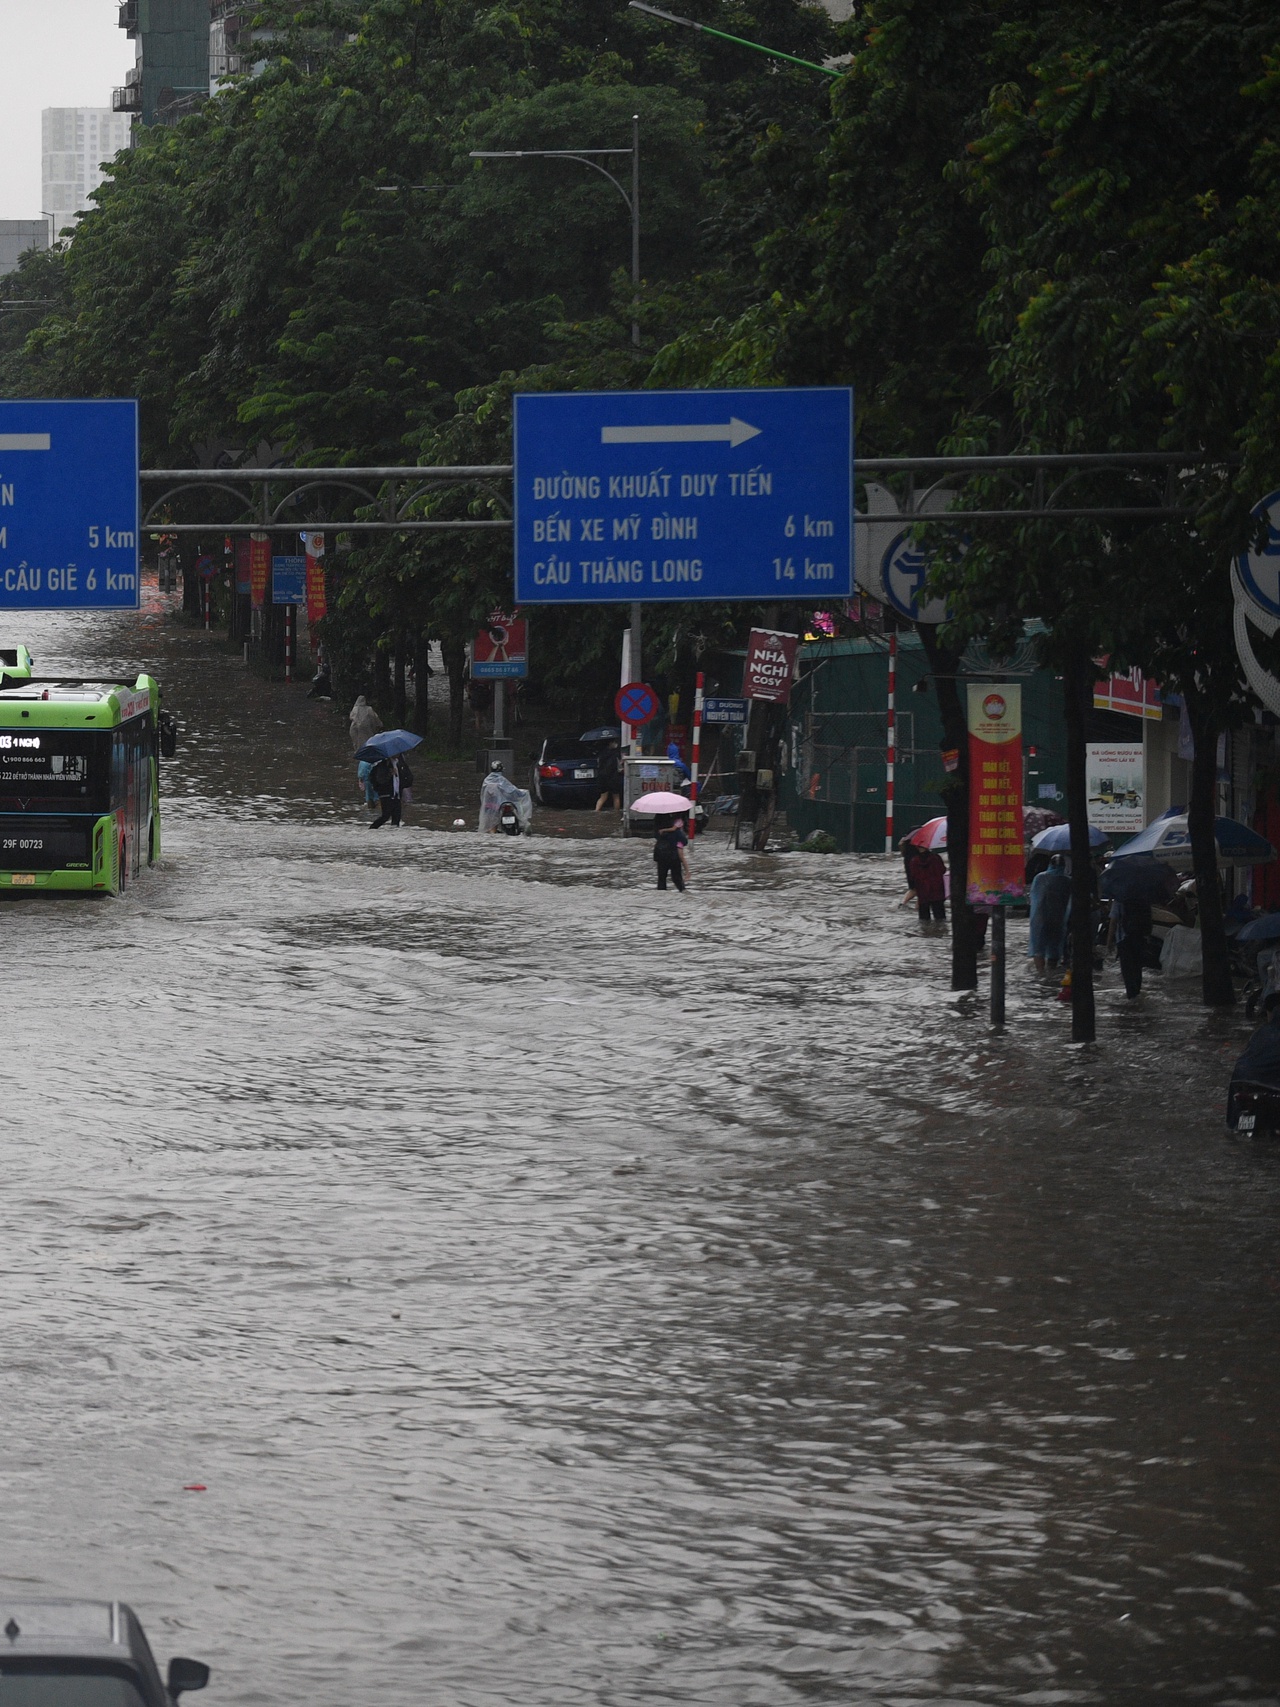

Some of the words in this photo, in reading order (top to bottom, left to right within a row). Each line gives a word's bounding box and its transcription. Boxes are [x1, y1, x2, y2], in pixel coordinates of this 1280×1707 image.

[533, 471, 601, 500] ĐƯỜNG
[609, 467, 672, 499] KHUẤT
[680, 474, 718, 497] DUY
[728, 464, 772, 496] TIẾN
[88, 525, 100, 549] 5
[105, 525, 135, 549] km
[533, 511, 571, 543] BẾN
[580, 518, 605, 542] XE
[612, 513, 641, 541] MỸ
[651, 512, 698, 540] ĐÌNH
[784, 515, 796, 538] 6
[804, 515, 834, 537] km
[47, 563, 78, 591] GIẼ
[86, 568, 97, 591] 6
[106, 567, 136, 591] km
[579, 556, 644, 584] THĂNG
[651, 559, 703, 583] LONG
[772, 557, 796, 581] 14
[804, 557, 834, 580] km
[753, 649, 787, 663] NHÀ
[752, 675, 782, 687] COSY
[2, 771, 13, 780] 222
[3, 839, 17, 849] 29F
[19, 839, 43, 849] 00723
